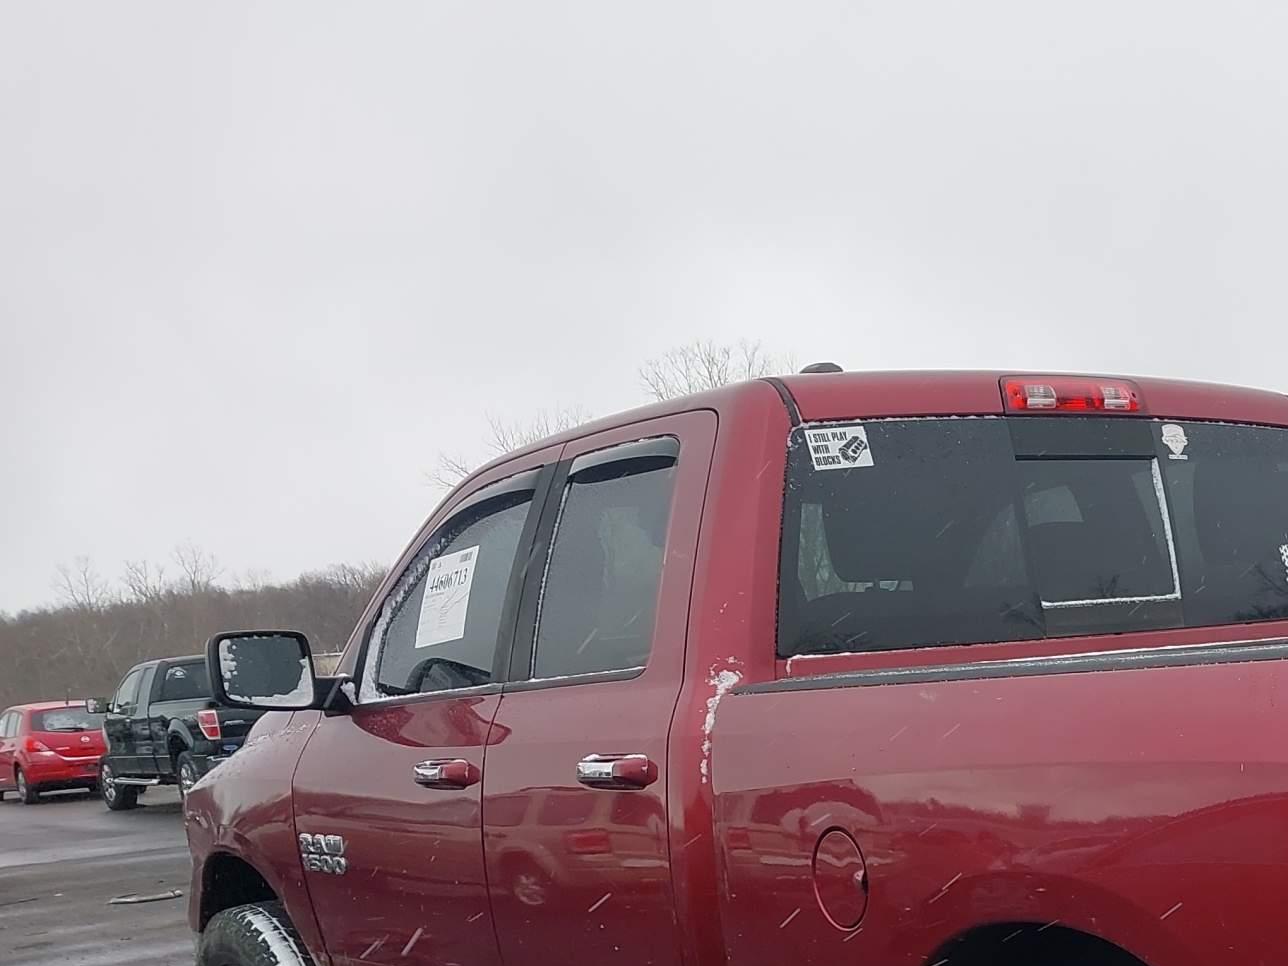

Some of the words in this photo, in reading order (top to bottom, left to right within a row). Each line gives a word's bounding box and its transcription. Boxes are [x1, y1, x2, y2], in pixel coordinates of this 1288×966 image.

[808, 433, 813, 443] I
[813, 433, 831, 443] STILL
[831, 431, 848, 442] PLAY
[812, 444, 831, 455] WITH
[814, 455, 842, 466] BLOCKS
[429, 567, 469, 593] 44606713
[299, 832, 344, 854] RAM
